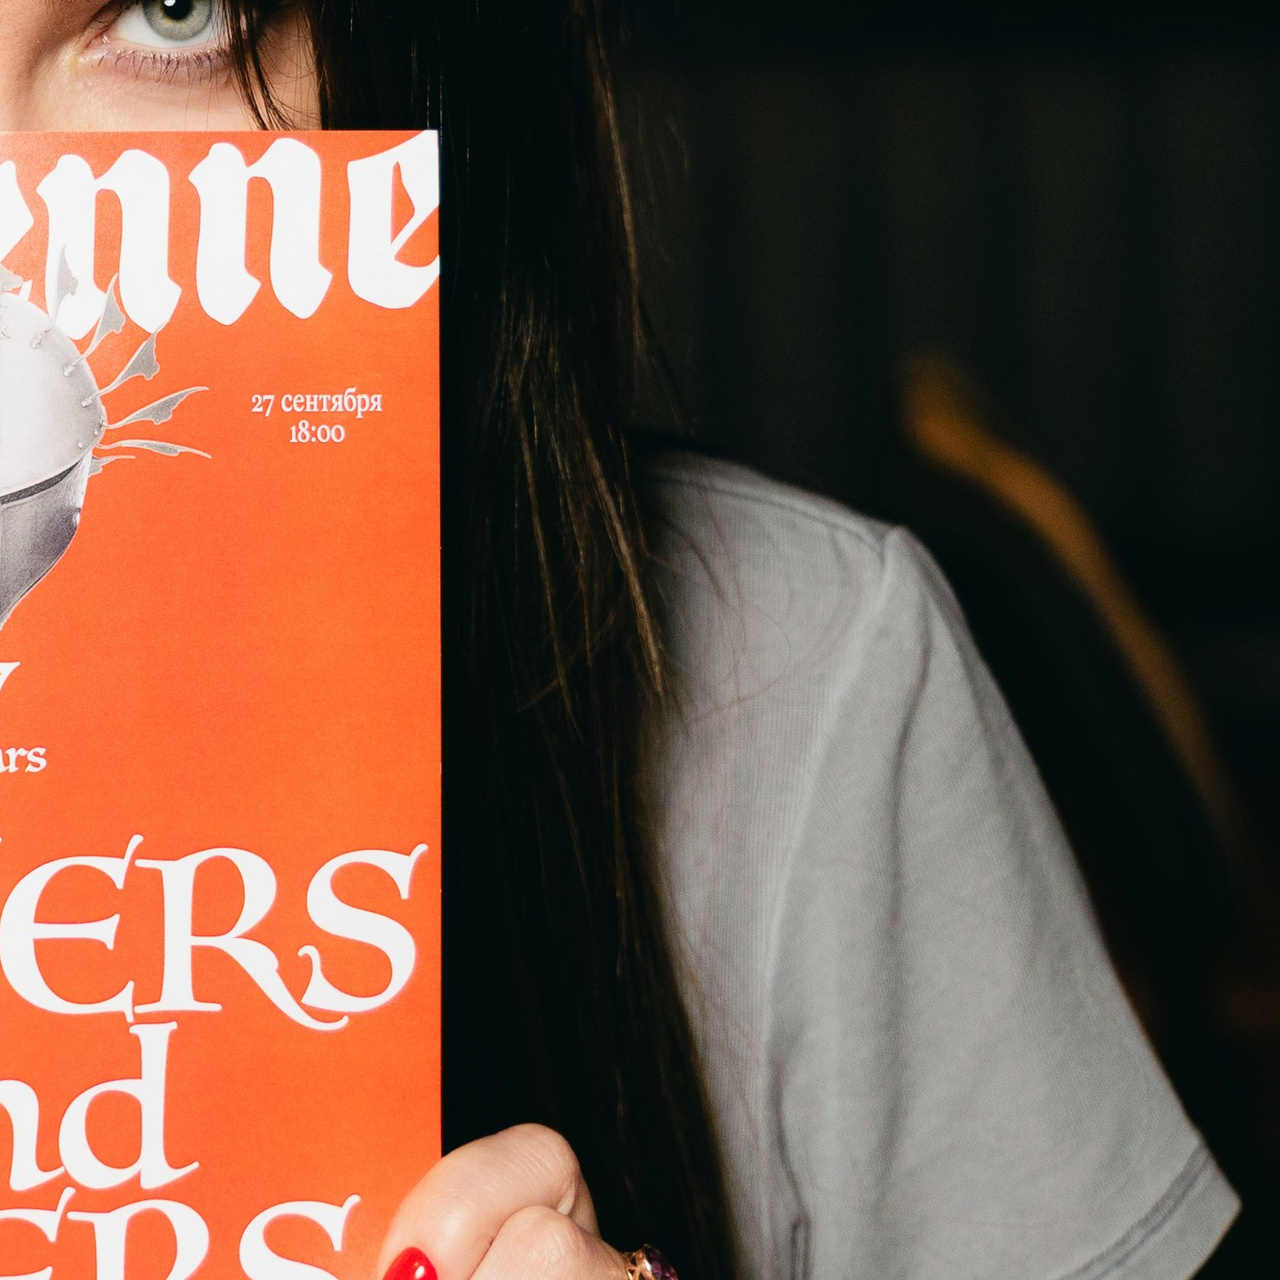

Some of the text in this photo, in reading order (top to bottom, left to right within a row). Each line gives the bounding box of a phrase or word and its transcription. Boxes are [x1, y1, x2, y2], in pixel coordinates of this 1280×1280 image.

[251, 387, 383, 418] 27 сентября
[289, 419, 346, 443] 18:00
